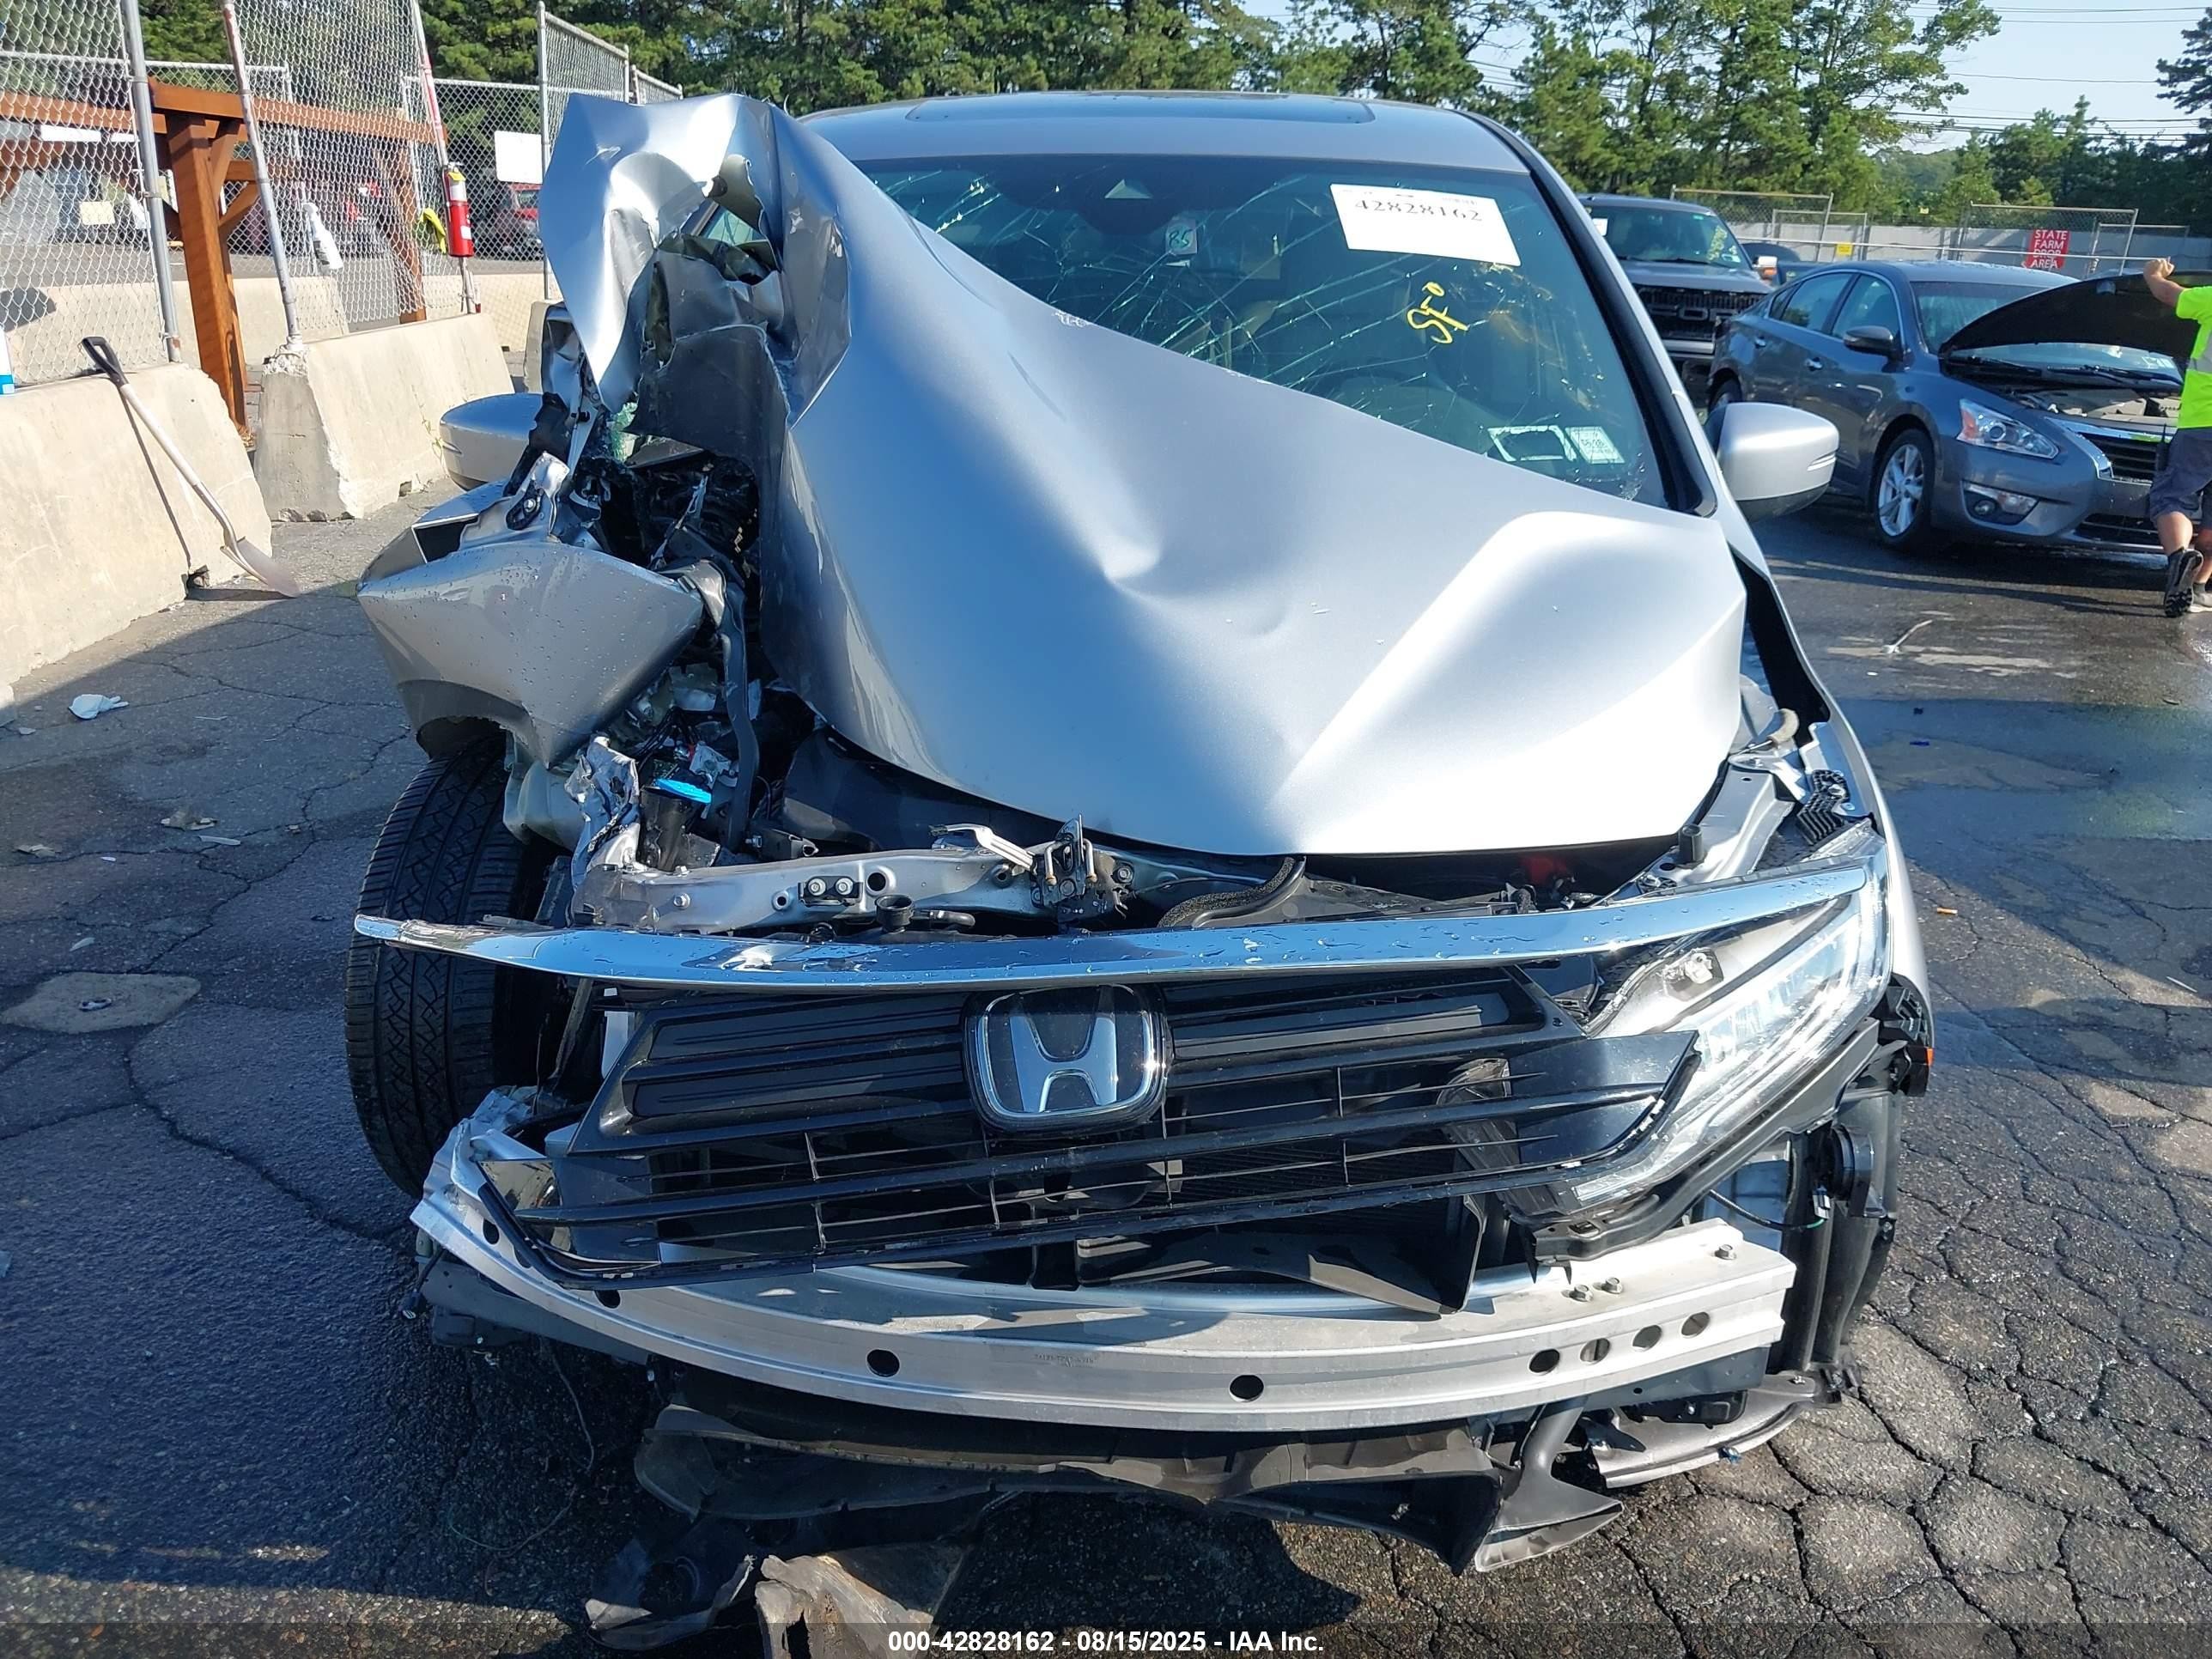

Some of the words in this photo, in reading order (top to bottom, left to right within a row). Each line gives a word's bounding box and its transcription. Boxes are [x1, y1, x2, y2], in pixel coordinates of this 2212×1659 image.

[2034, 229, 2068, 240] STATE
[2034, 240, 2064, 249] FARM
[2030, 259, 2058, 269] AREA
